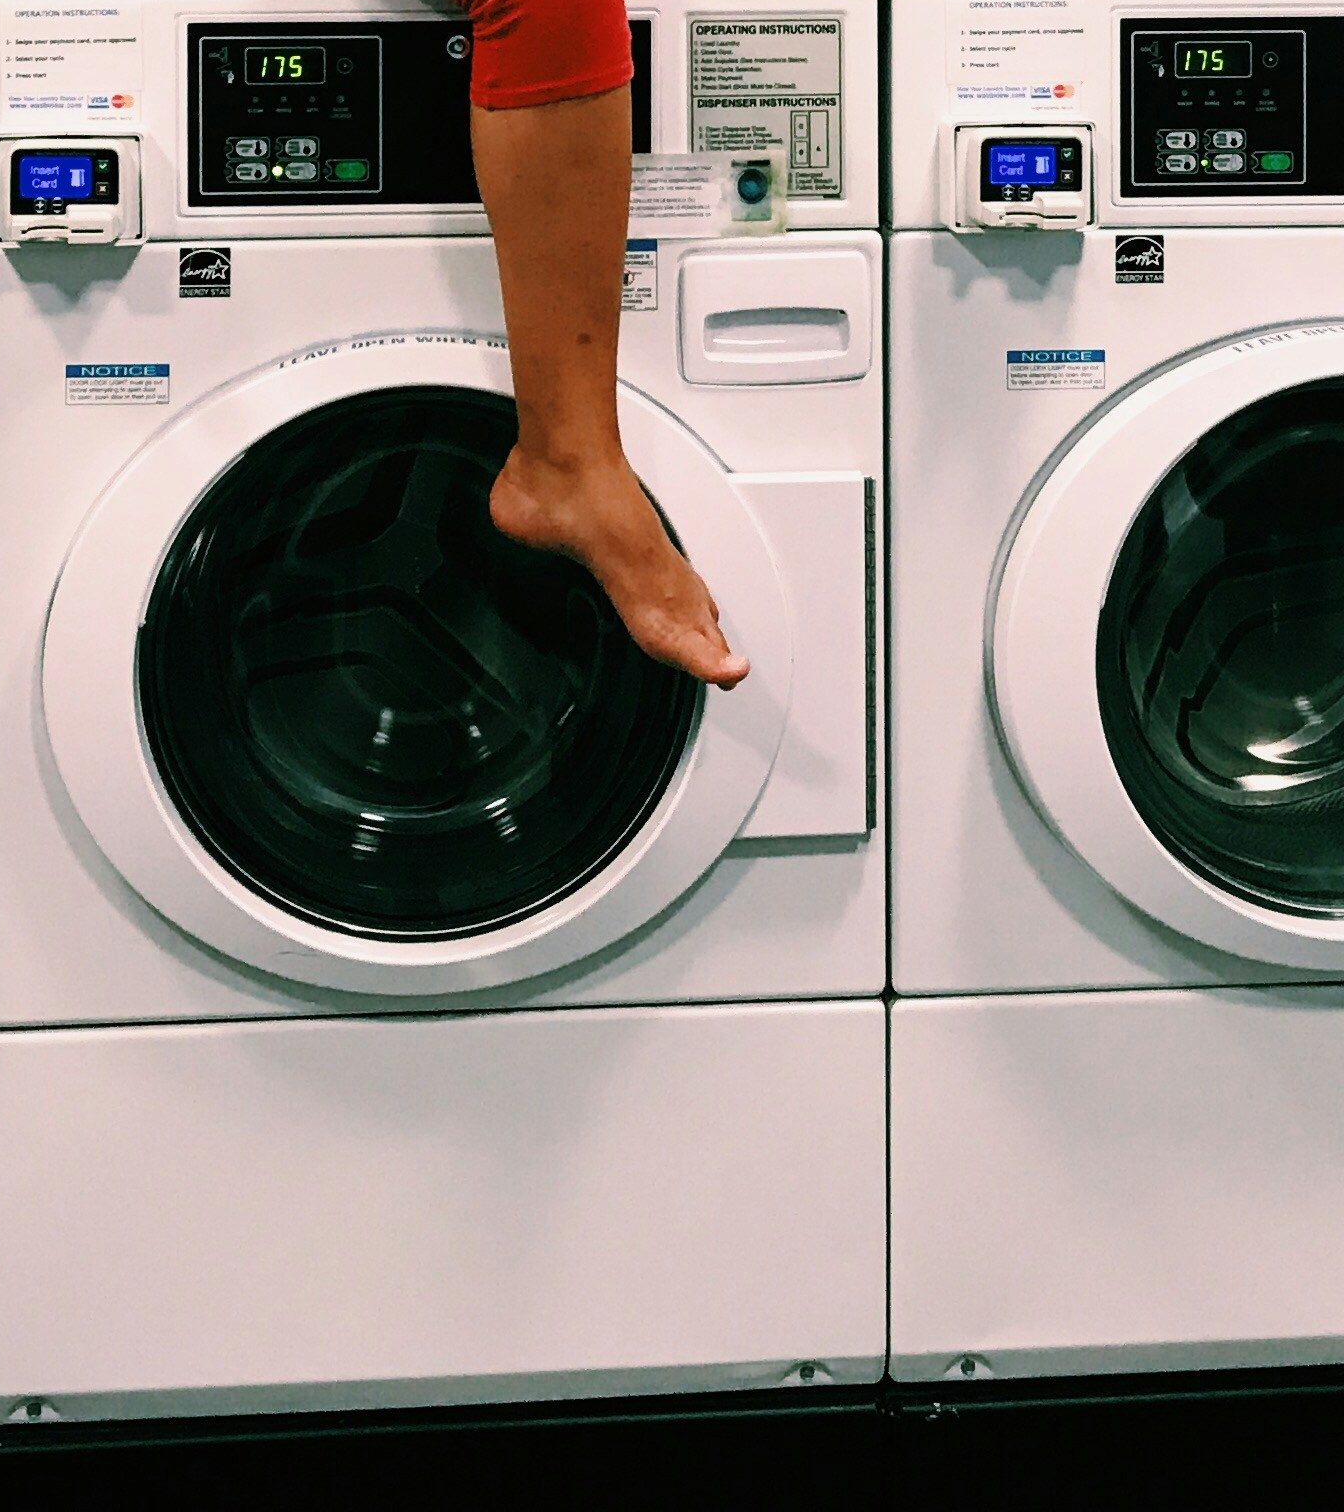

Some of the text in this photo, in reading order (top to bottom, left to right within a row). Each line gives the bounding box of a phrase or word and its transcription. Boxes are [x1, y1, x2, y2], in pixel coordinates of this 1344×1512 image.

[696, 24, 836, 35] OPERATING INSTRUCTIONS
[1184, 49, 1224, 71] 175
[261, 55, 303, 78] 175
[698, 98, 836, 108] DISPENSER INSTRUCTIONS
[998, 153, 1025, 162] Insert
[30, 166, 60, 175] Insert
[999, 165, 1023, 175] Card
[32, 178, 57, 188] Card
[1021, 352, 1093, 361] NOTICE
[81, 366, 156, 376] NOTICE
